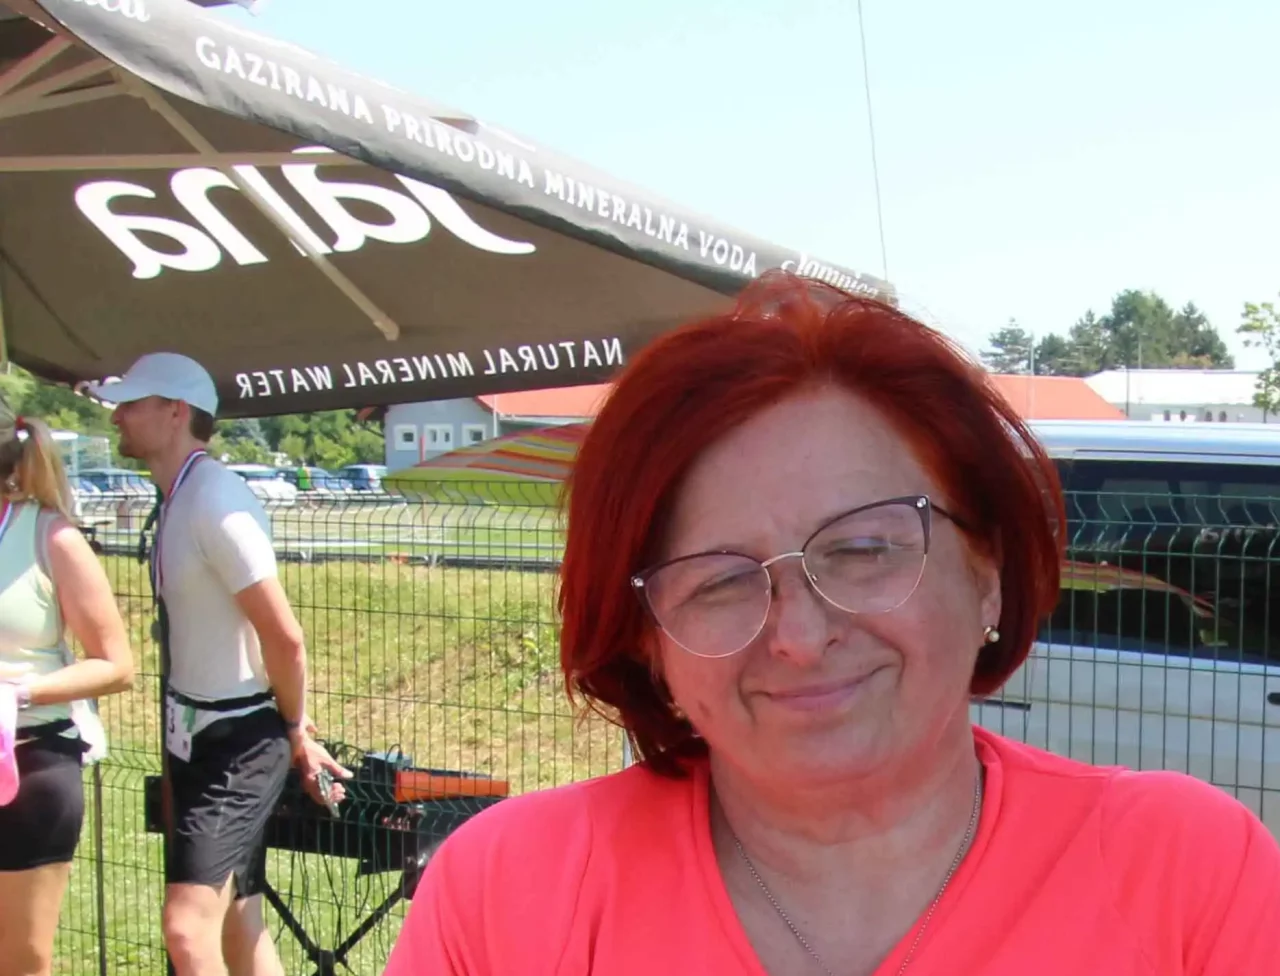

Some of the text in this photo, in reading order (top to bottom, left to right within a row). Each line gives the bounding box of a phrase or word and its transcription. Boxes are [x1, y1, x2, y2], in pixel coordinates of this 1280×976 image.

[195, 35, 757, 278] GAZIRANA PRIRODNA MINERALNA VODA
